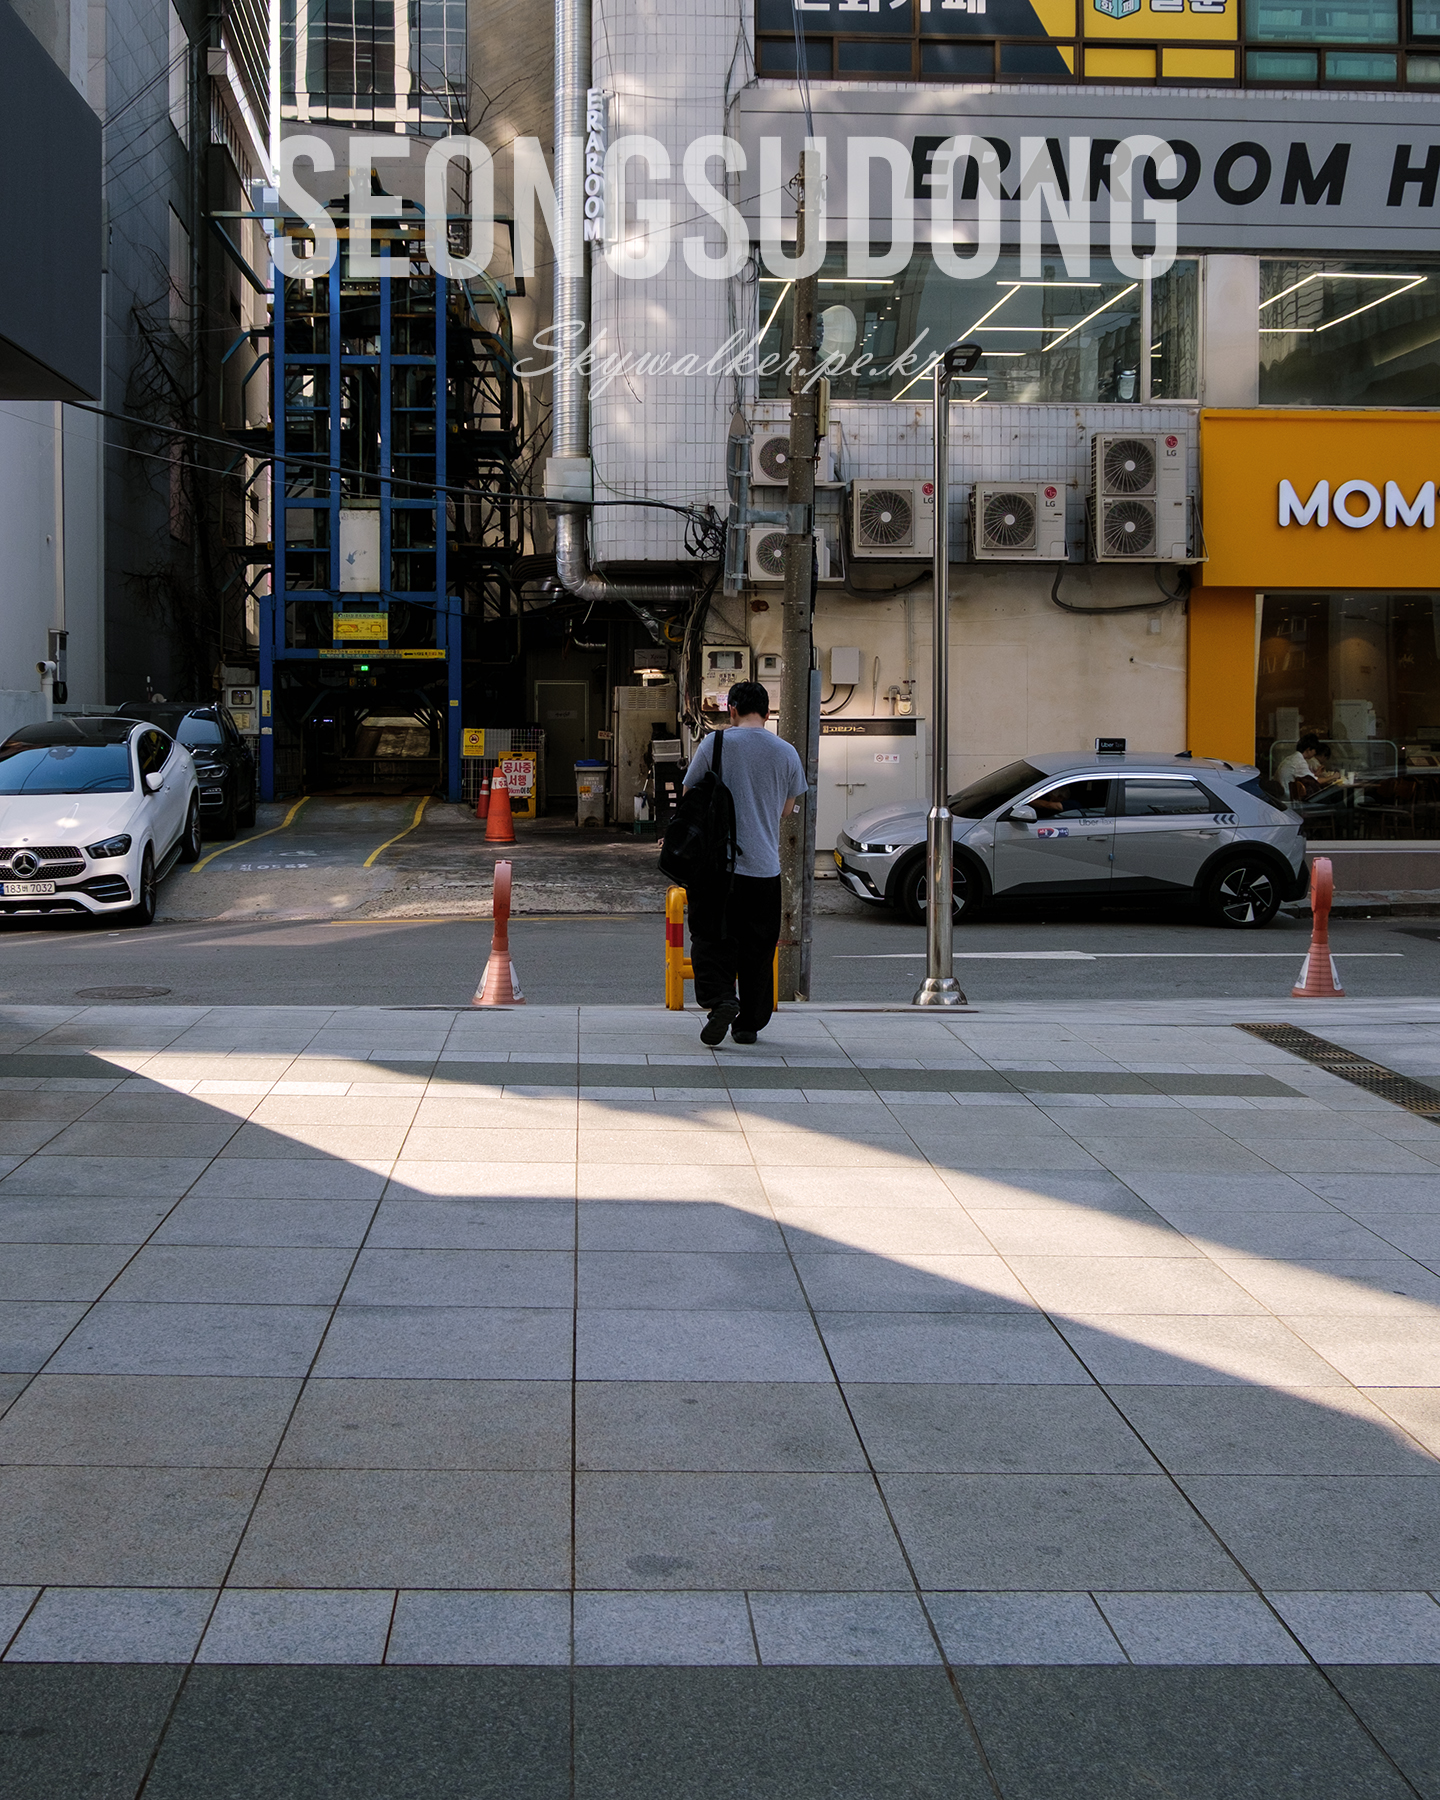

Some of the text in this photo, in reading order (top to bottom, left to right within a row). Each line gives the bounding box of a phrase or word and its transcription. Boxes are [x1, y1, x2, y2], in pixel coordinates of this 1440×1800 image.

[584, 88, 605, 242] ERAROOM
[906, 136, 1351, 206] ERAROOM
[1279, 479, 1440, 529] MOM
[504, 762, 531, 774] 공사중
[509, 775, 527, 787] 서행
[30, 883, 53, 893] 7032
